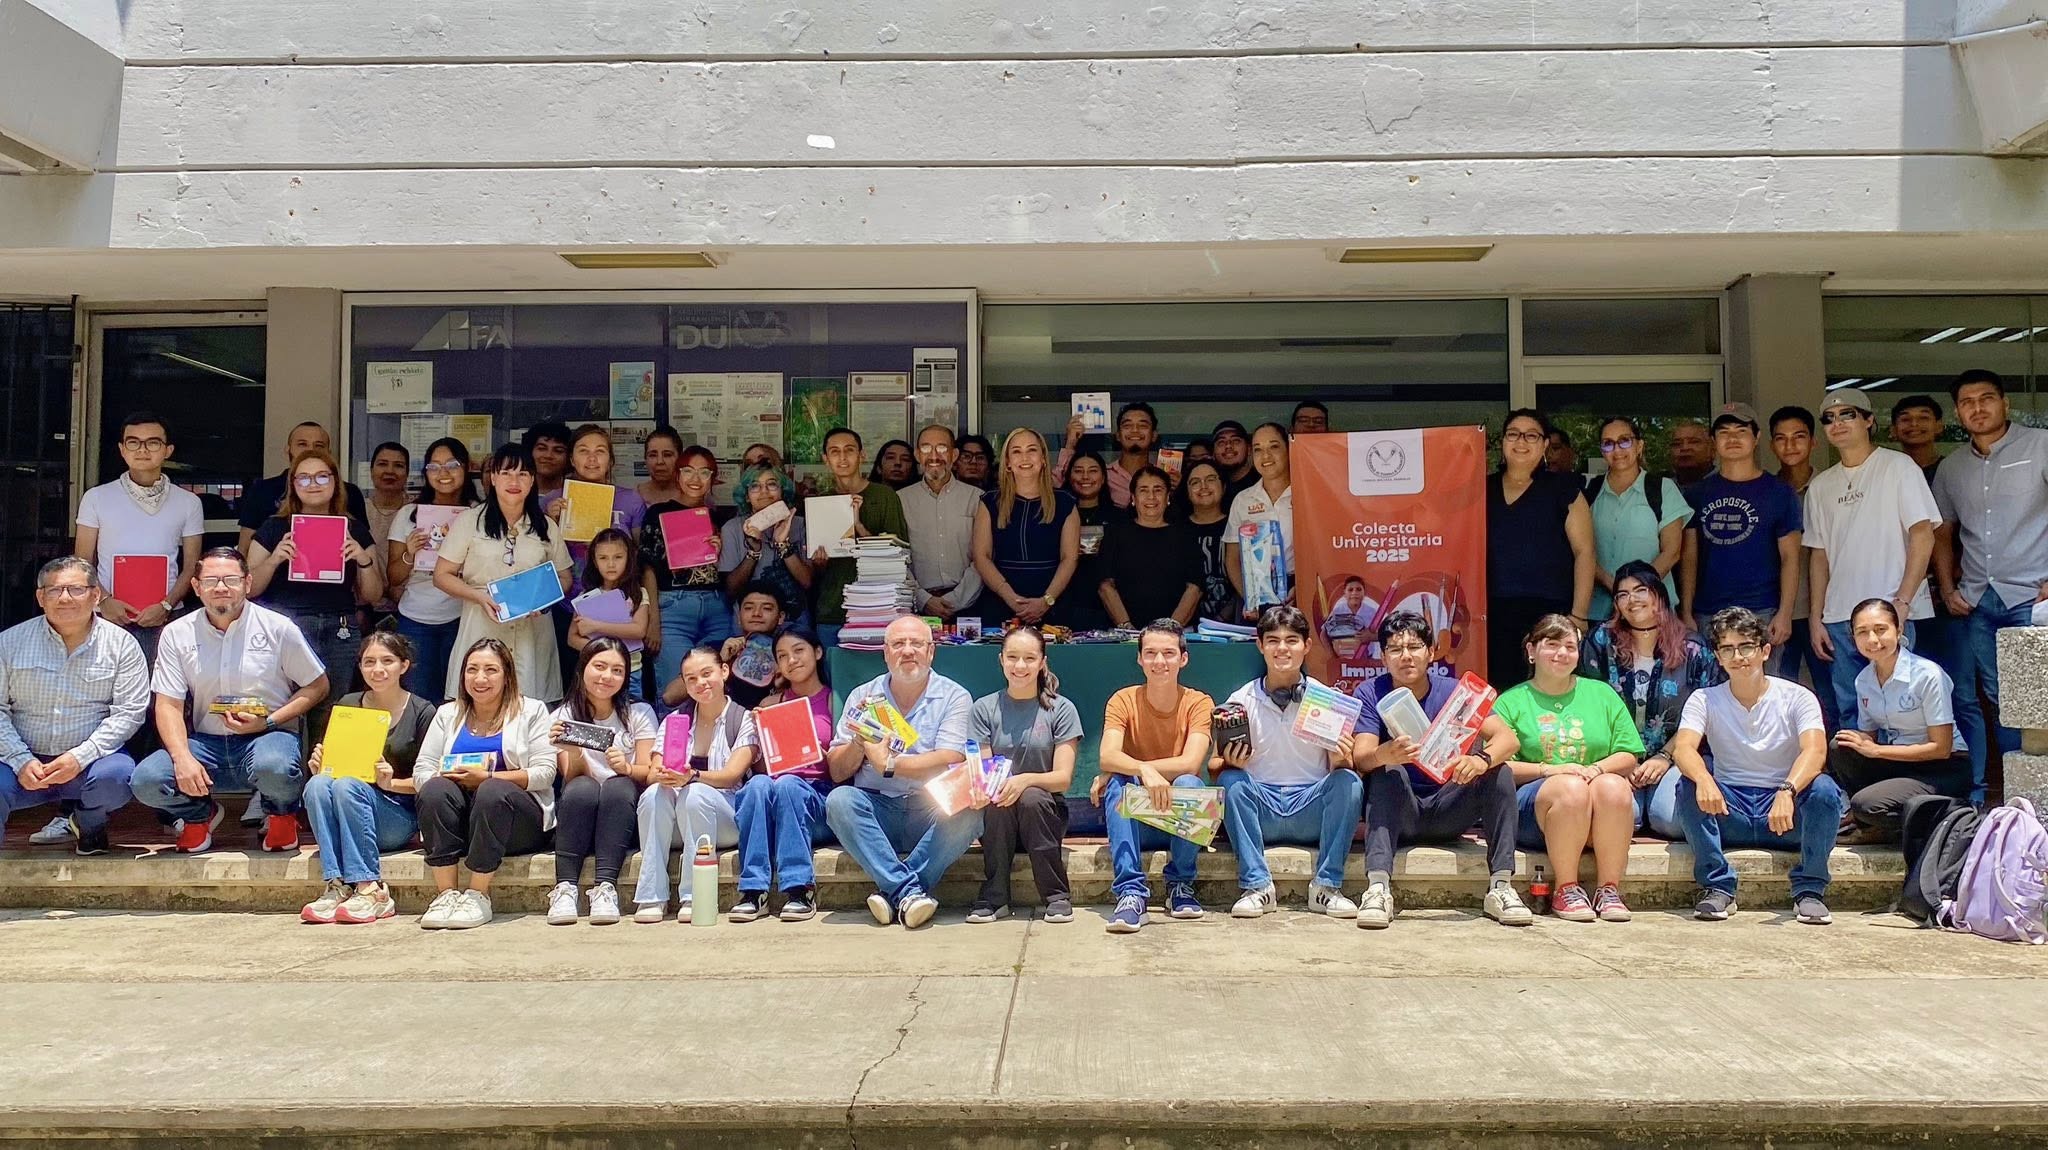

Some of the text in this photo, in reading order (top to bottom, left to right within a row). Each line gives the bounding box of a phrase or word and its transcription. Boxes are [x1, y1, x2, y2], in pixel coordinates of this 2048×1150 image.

[1700, 496, 1759, 523] AEROPOSTALE
[1352, 522, 1416, 535] Colecta
[1332, 533, 1443, 549] Universitaria
[1366, 548, 1410, 563] 2025
[1341, 662, 1449, 681] Impudo
